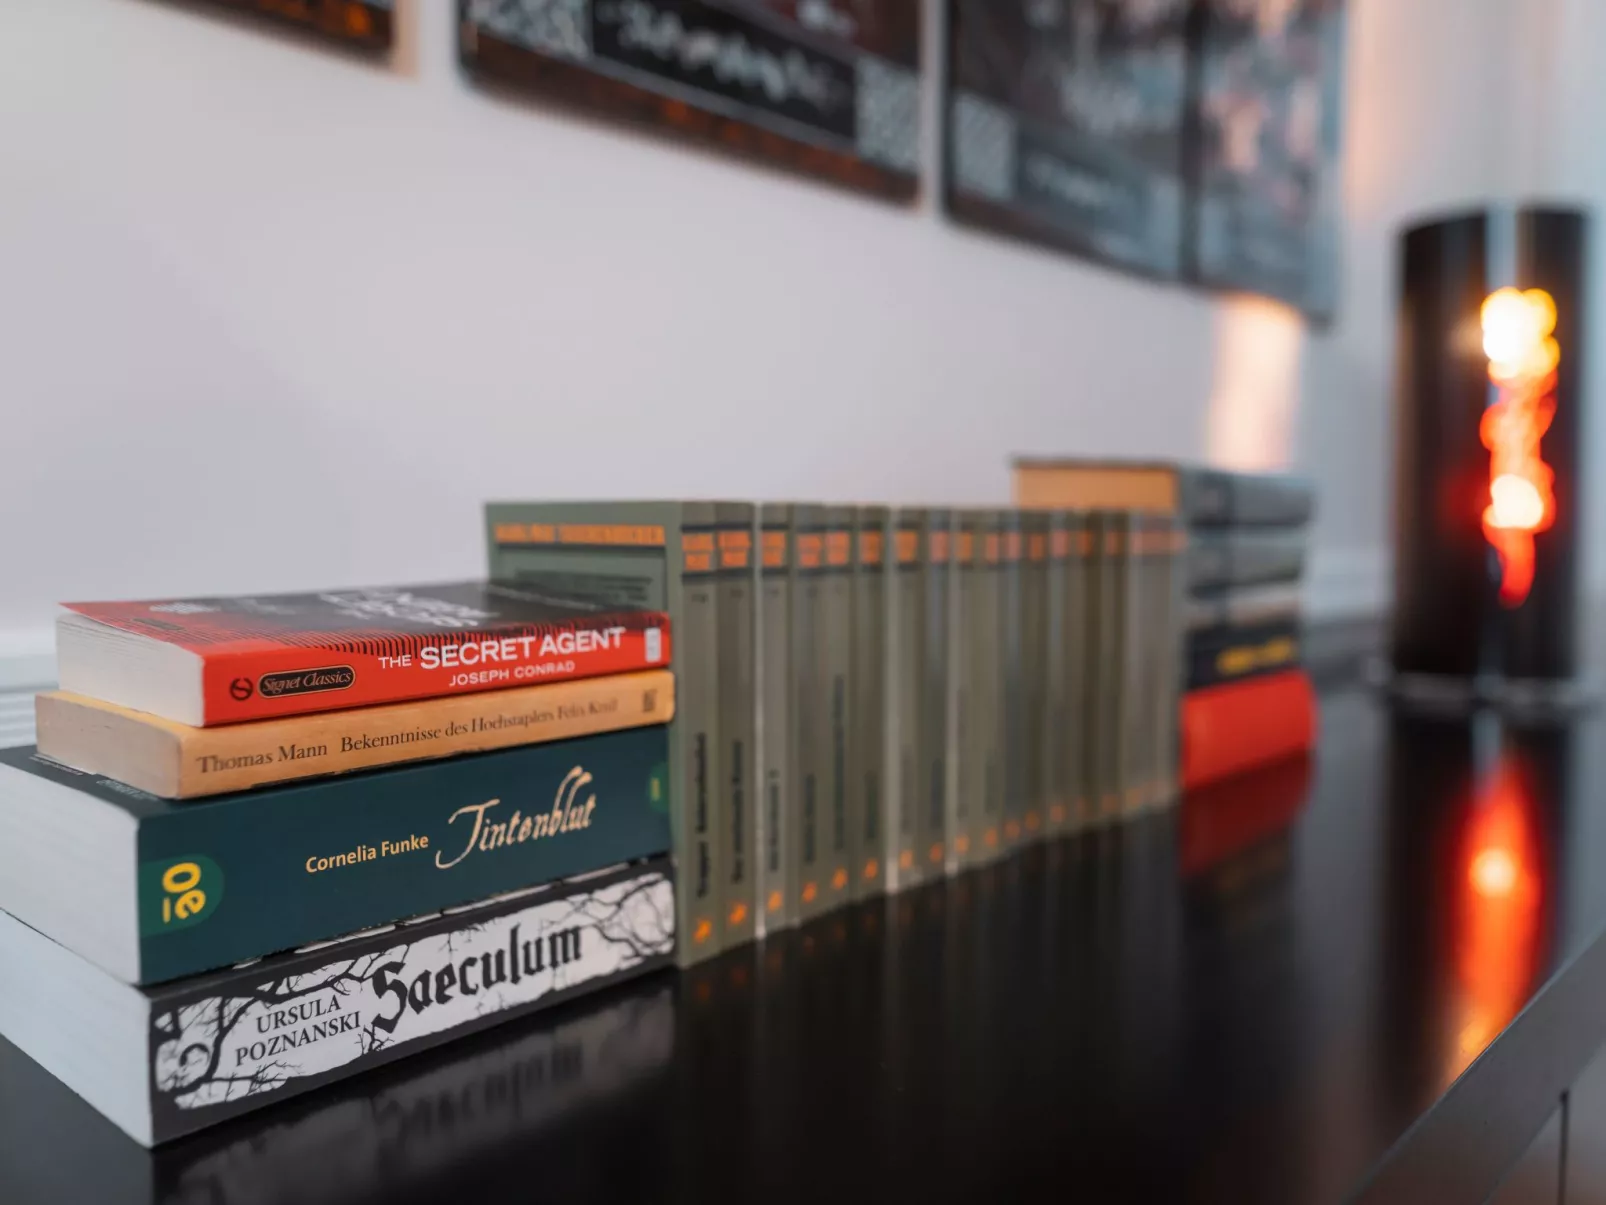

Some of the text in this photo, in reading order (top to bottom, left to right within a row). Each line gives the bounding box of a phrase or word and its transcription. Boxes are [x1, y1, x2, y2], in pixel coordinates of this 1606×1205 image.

[378, 626, 626, 670] THE SECRET AGENT
[262, 670, 352, 694] Signet Classics
[449, 660, 576, 687] JOSEPH CONRAD
[198, 753, 273, 774] Thomas
[277, 743, 328, 763] Mann
[339, 725, 442, 753] Bekenntnisse
[445, 721, 469, 738] des
[435, 765, 597, 870] Tintenblut
[305, 834, 429, 874] Cornelia Funke
[370, 923, 583, 1034] Saeculum
[256, 994, 342, 1034] URSULA
[235, 1010, 362, 1067] POZNANSKI
